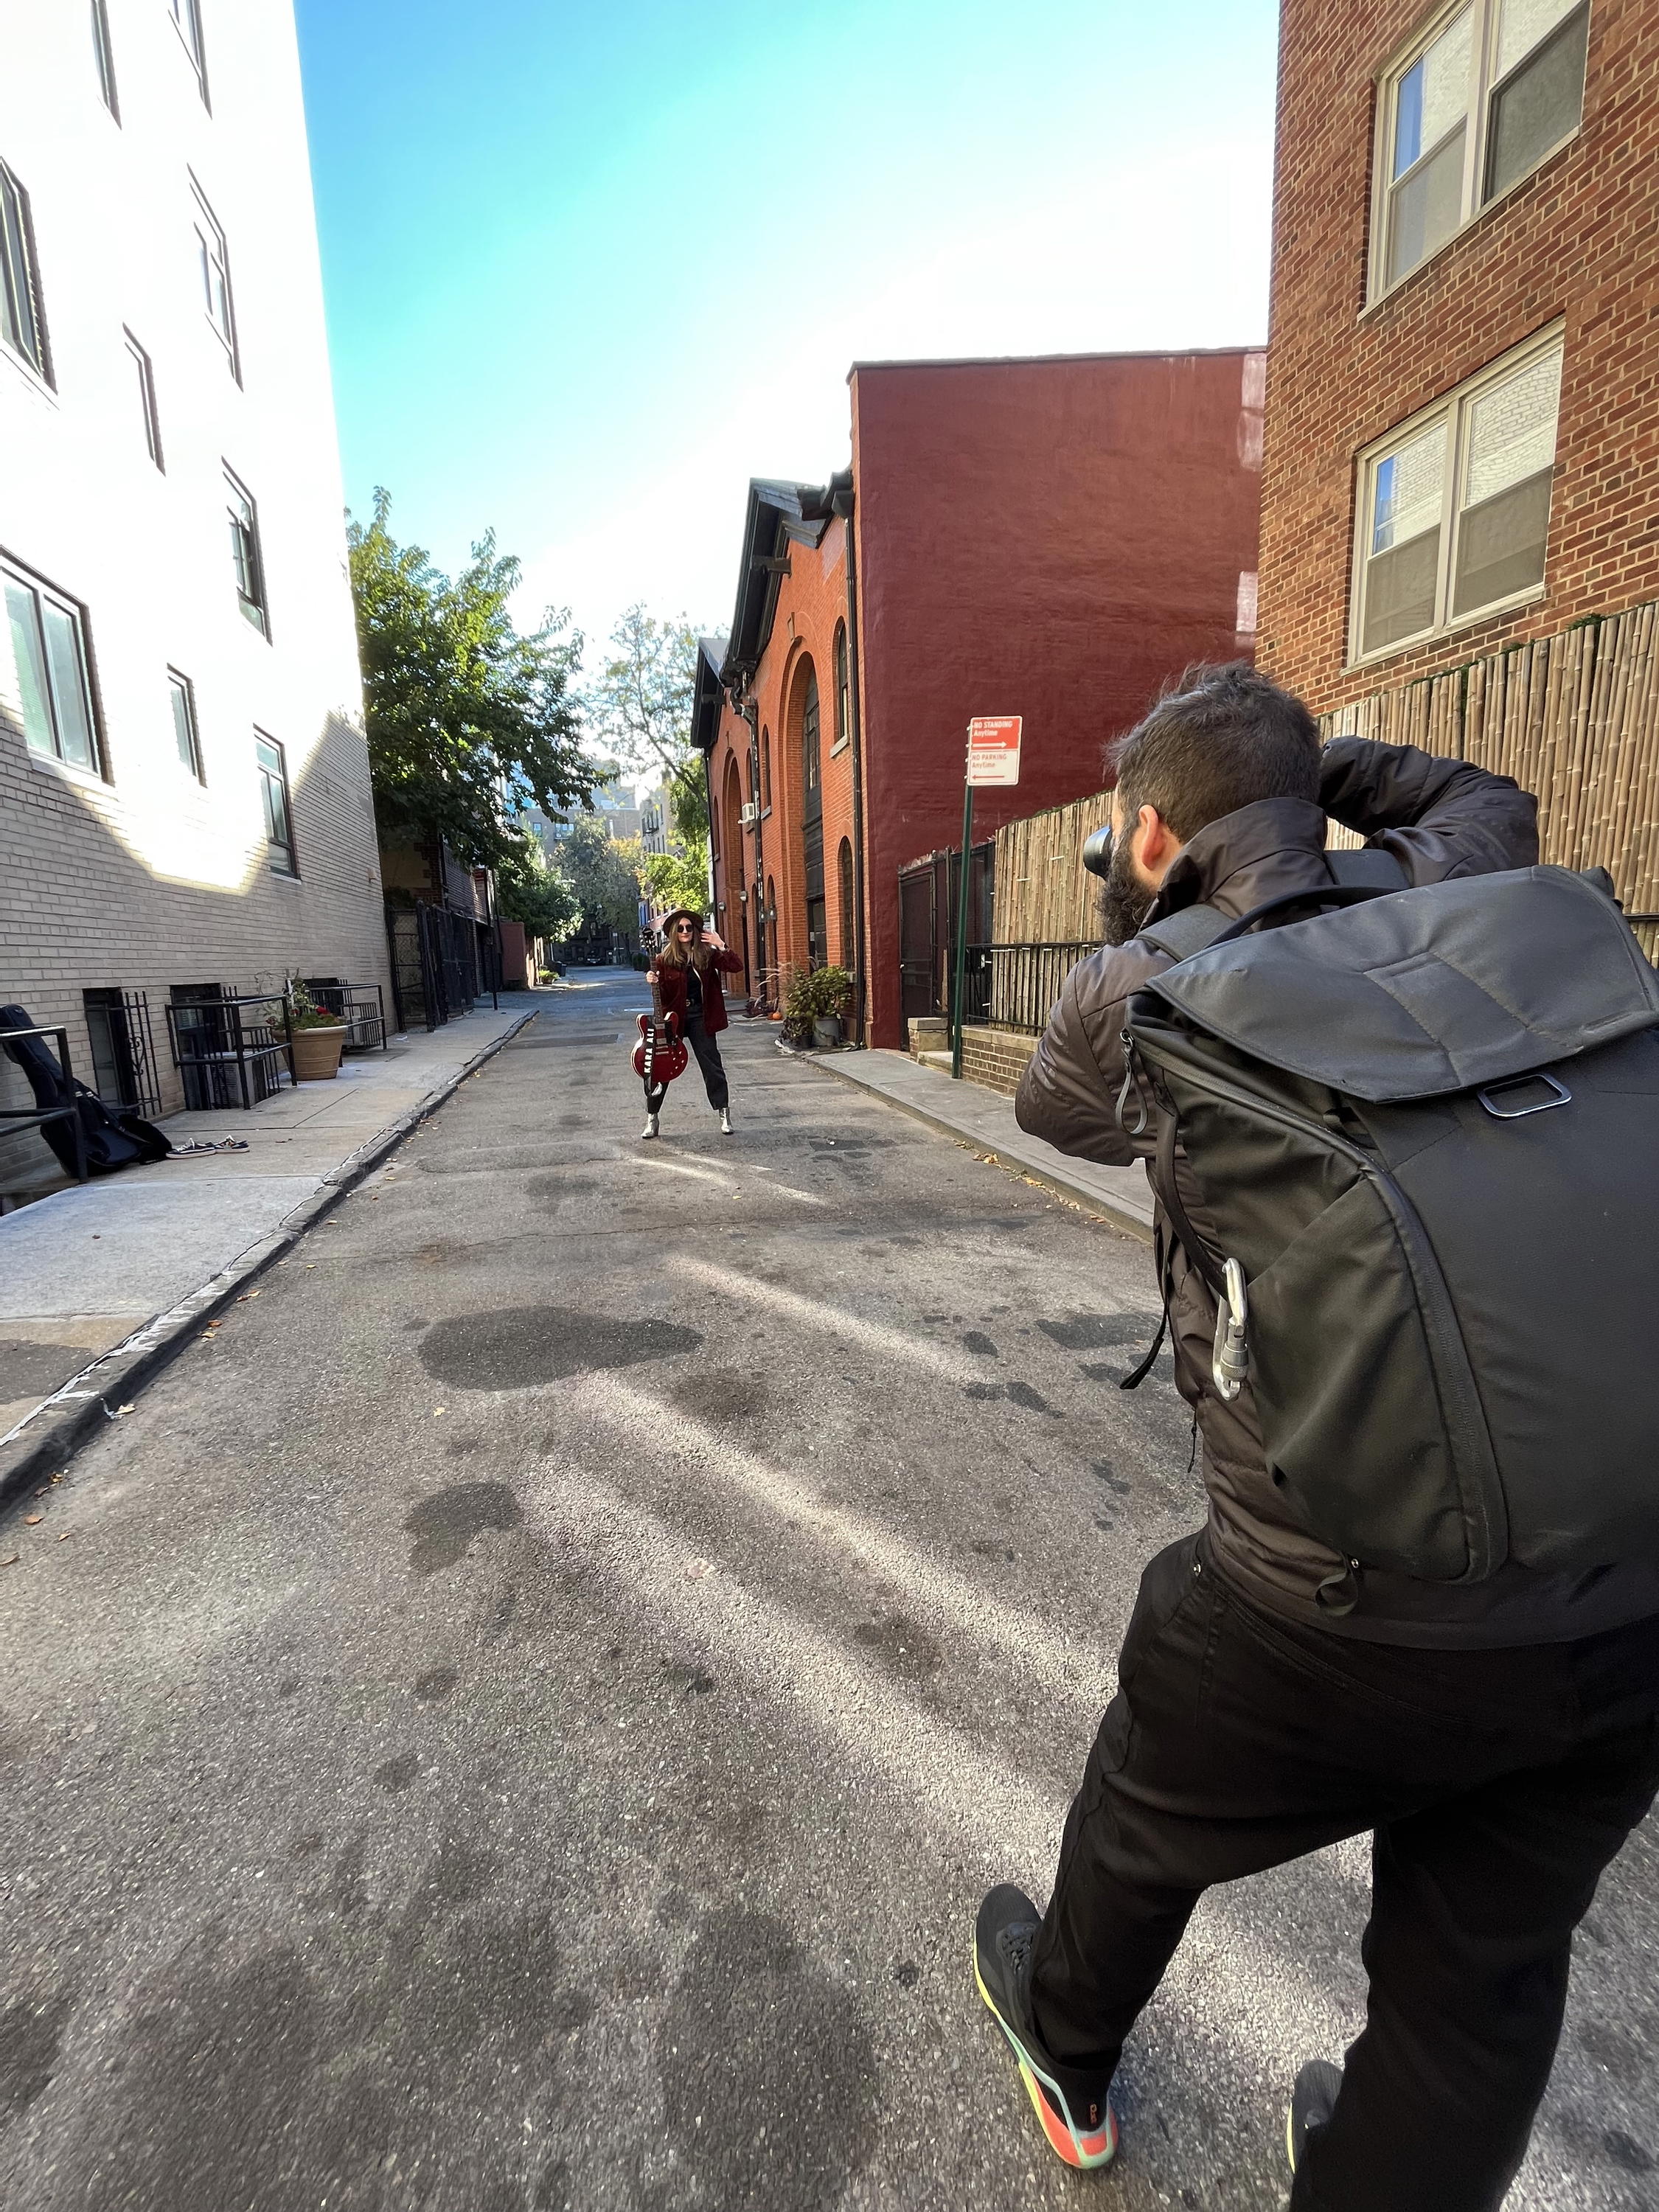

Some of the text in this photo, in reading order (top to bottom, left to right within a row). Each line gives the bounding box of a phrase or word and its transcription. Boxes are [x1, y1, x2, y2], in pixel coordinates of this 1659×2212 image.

[973, 729, 998, 737] Anytime
[644, 1028, 655, 1074] KARA ALI
